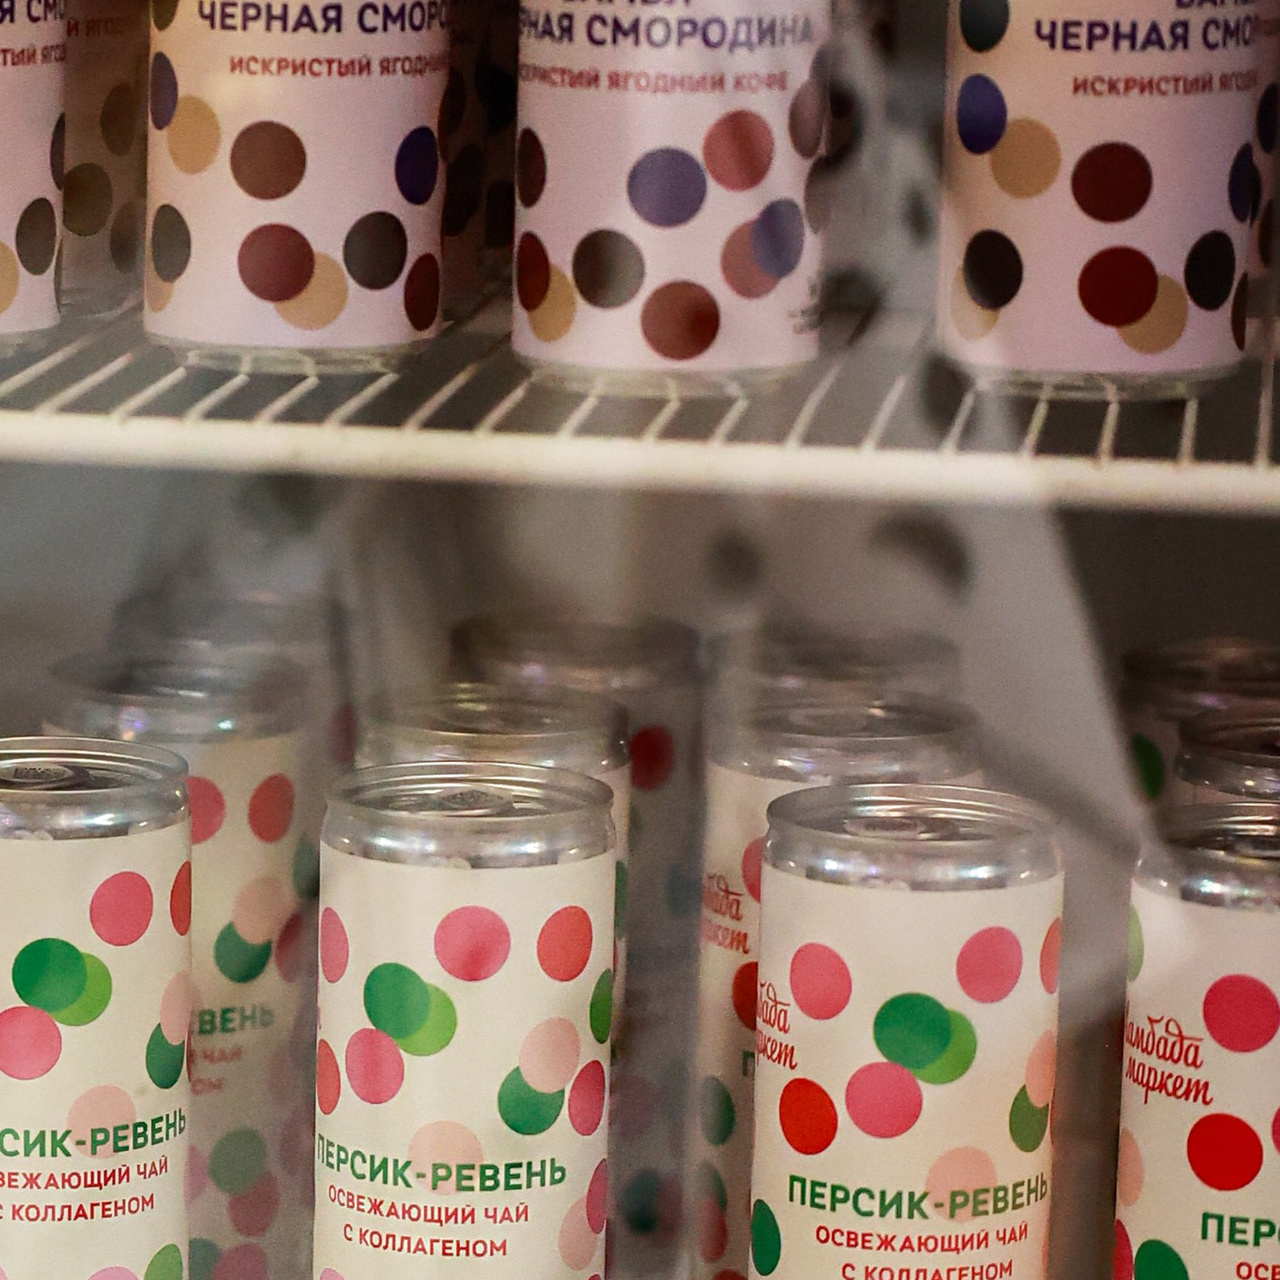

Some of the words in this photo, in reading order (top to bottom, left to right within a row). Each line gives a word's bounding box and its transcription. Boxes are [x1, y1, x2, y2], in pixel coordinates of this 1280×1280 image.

[198, 0, 343, 33] ЧЕРНАЯ
[586, 12, 813, 54] СМОРОДИНА
[1035, 20, 1189, 51] ЧЕРНАЯ
[230, 54, 371, 77] ИСКРИСТЫЙ
[608, 70, 726, 93] ЯГОДНЫЙ
[1073, 73, 1213, 96] ИСКРИСТЫЙ
[1126, 1056, 1214, 1106] маркет
[136, 1154, 168, 1180] ЧАЙ
[317, 1133, 567, 1192] ПЕРСИК-РЕВЕНЬ
[11, 1193, 154, 1222] КОЛЛАГЕНОМ
[328, 1184, 476, 1227] ОСВЕЖАЮЩИЙ
[484, 1201, 528, 1224] ЧАЙ
[789, 1172, 1048, 1219] ПЕРСИК-РЕВЕНЬ
[343, 1223, 353, 1241] С
[359, 1228, 508, 1257] КОЛЛАГЕНОМ
[816, 1225, 989, 1255] ОСВЕЖАЮЩИЙ
[996, 1220, 1028, 1246] ЧАЙ
[841, 1263, 855, 1280] С
